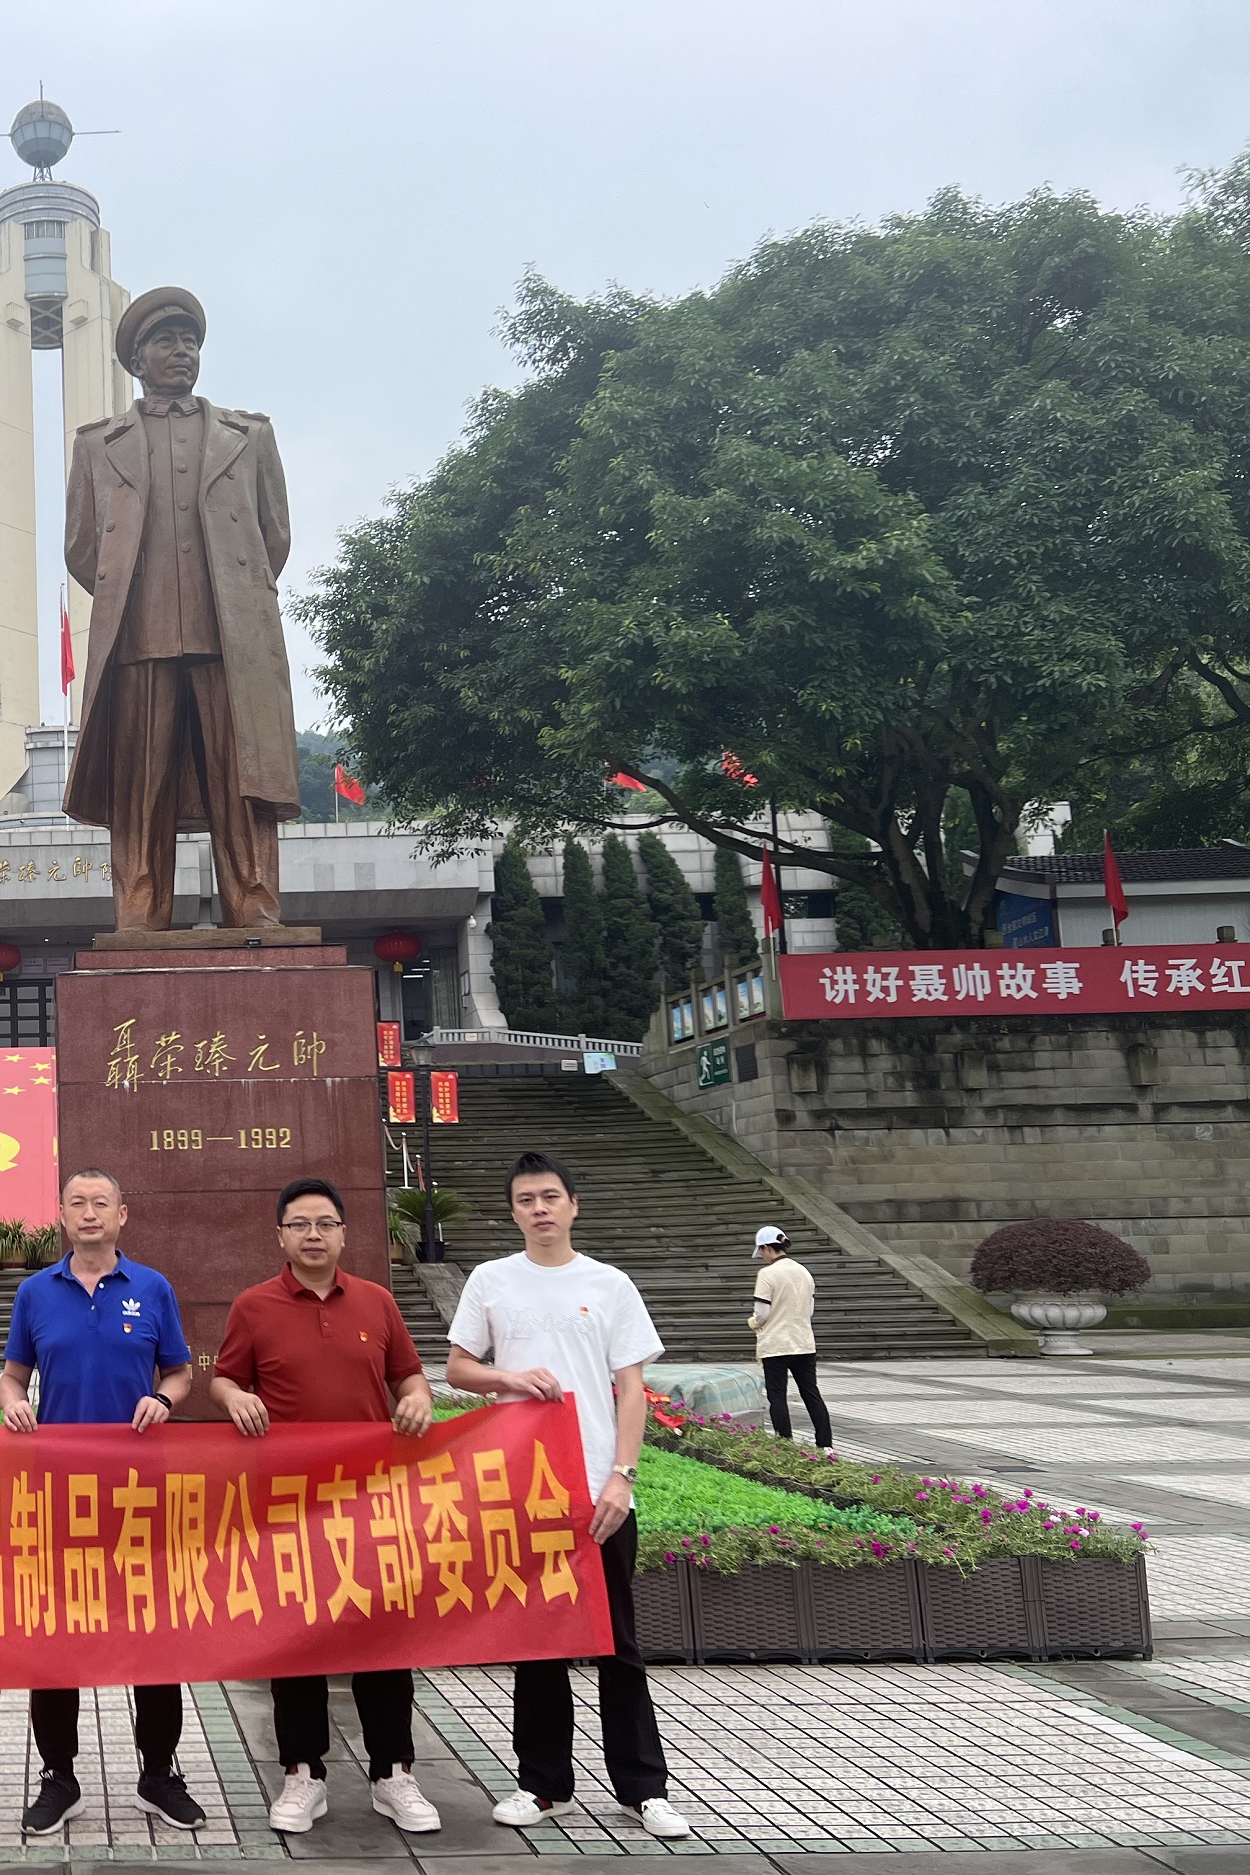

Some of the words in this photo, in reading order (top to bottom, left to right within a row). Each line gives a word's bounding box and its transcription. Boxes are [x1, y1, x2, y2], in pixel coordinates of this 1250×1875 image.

[819, 960, 1083, 1004] 讲好聂帅故事
[1120, 957, 1250, 998] 传承红
